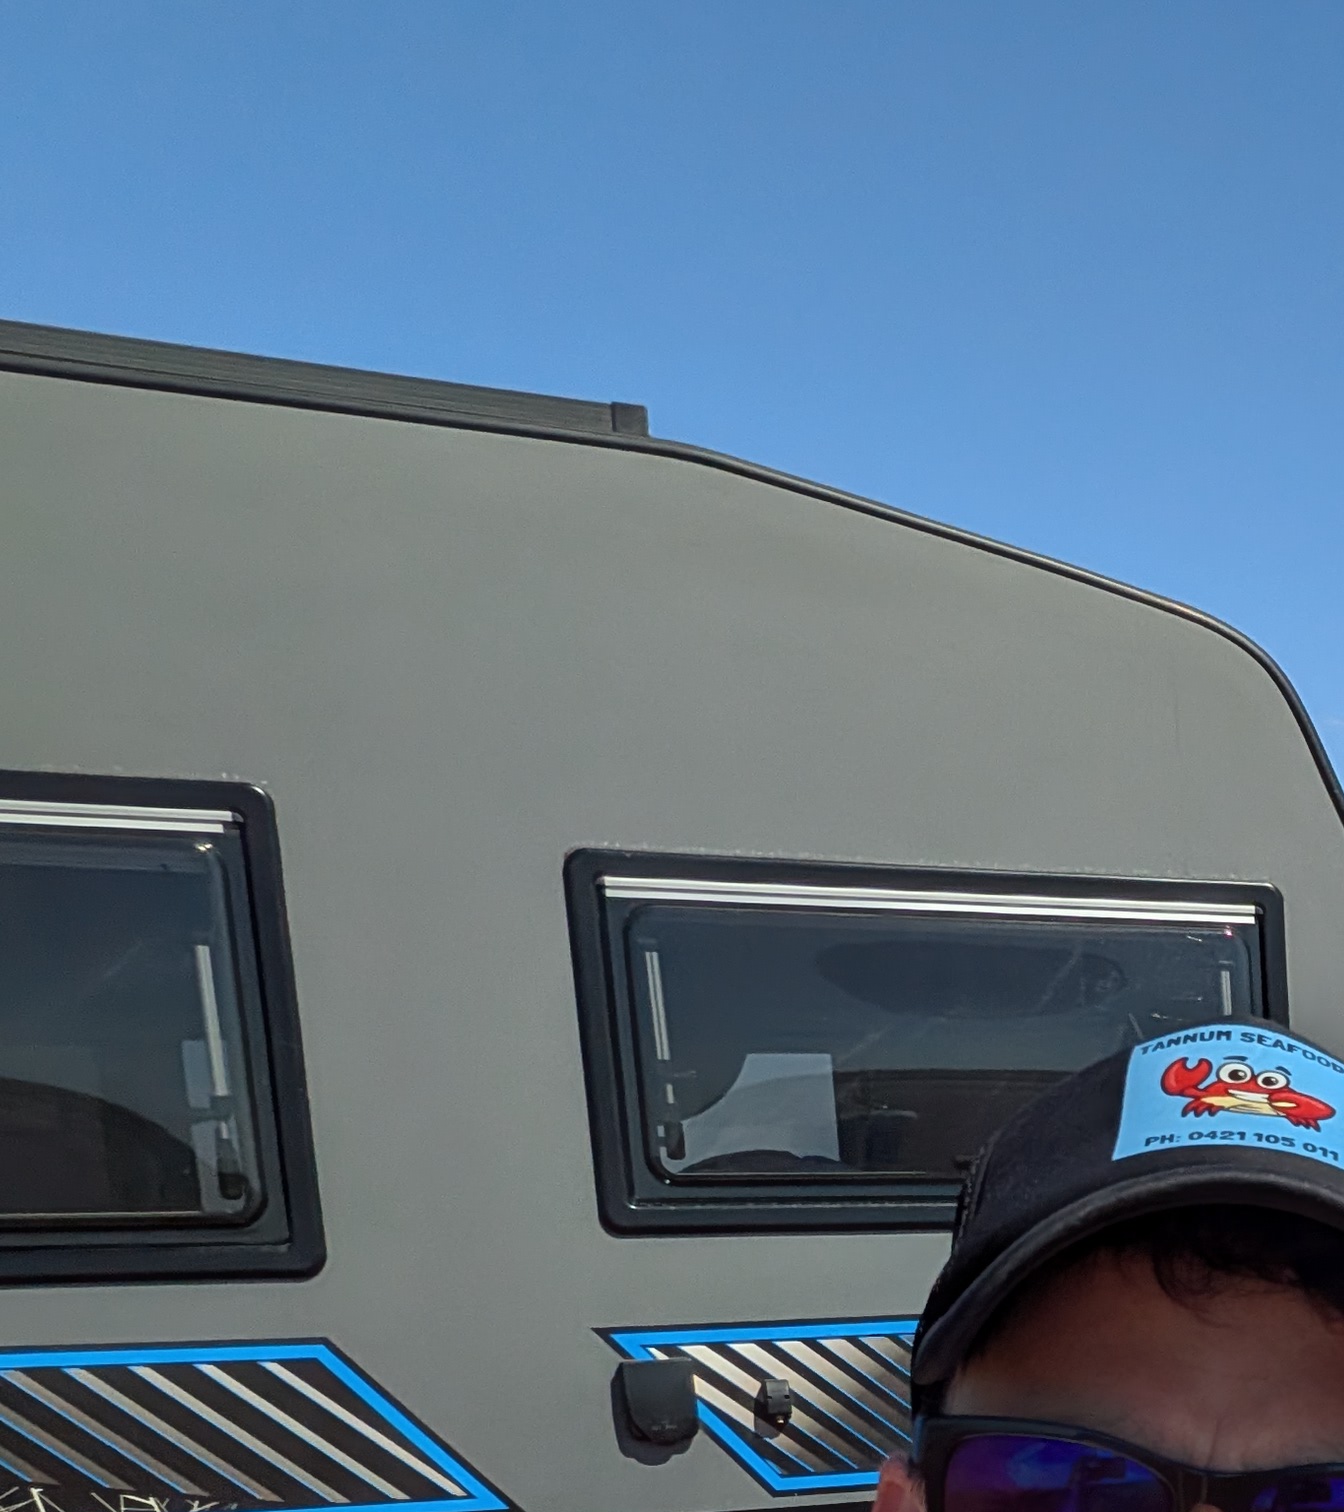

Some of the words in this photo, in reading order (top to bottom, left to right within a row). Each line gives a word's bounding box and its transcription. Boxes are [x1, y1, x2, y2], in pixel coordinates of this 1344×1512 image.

[1140, 1030, 1232, 1055] TANNUM
[1143, 1133, 1182, 1147] PH:
[1188, 1130, 1246, 1141] 0421
[1253, 1132, 1296, 1148] 105
[1302, 1141, 1340, 1162] 011
